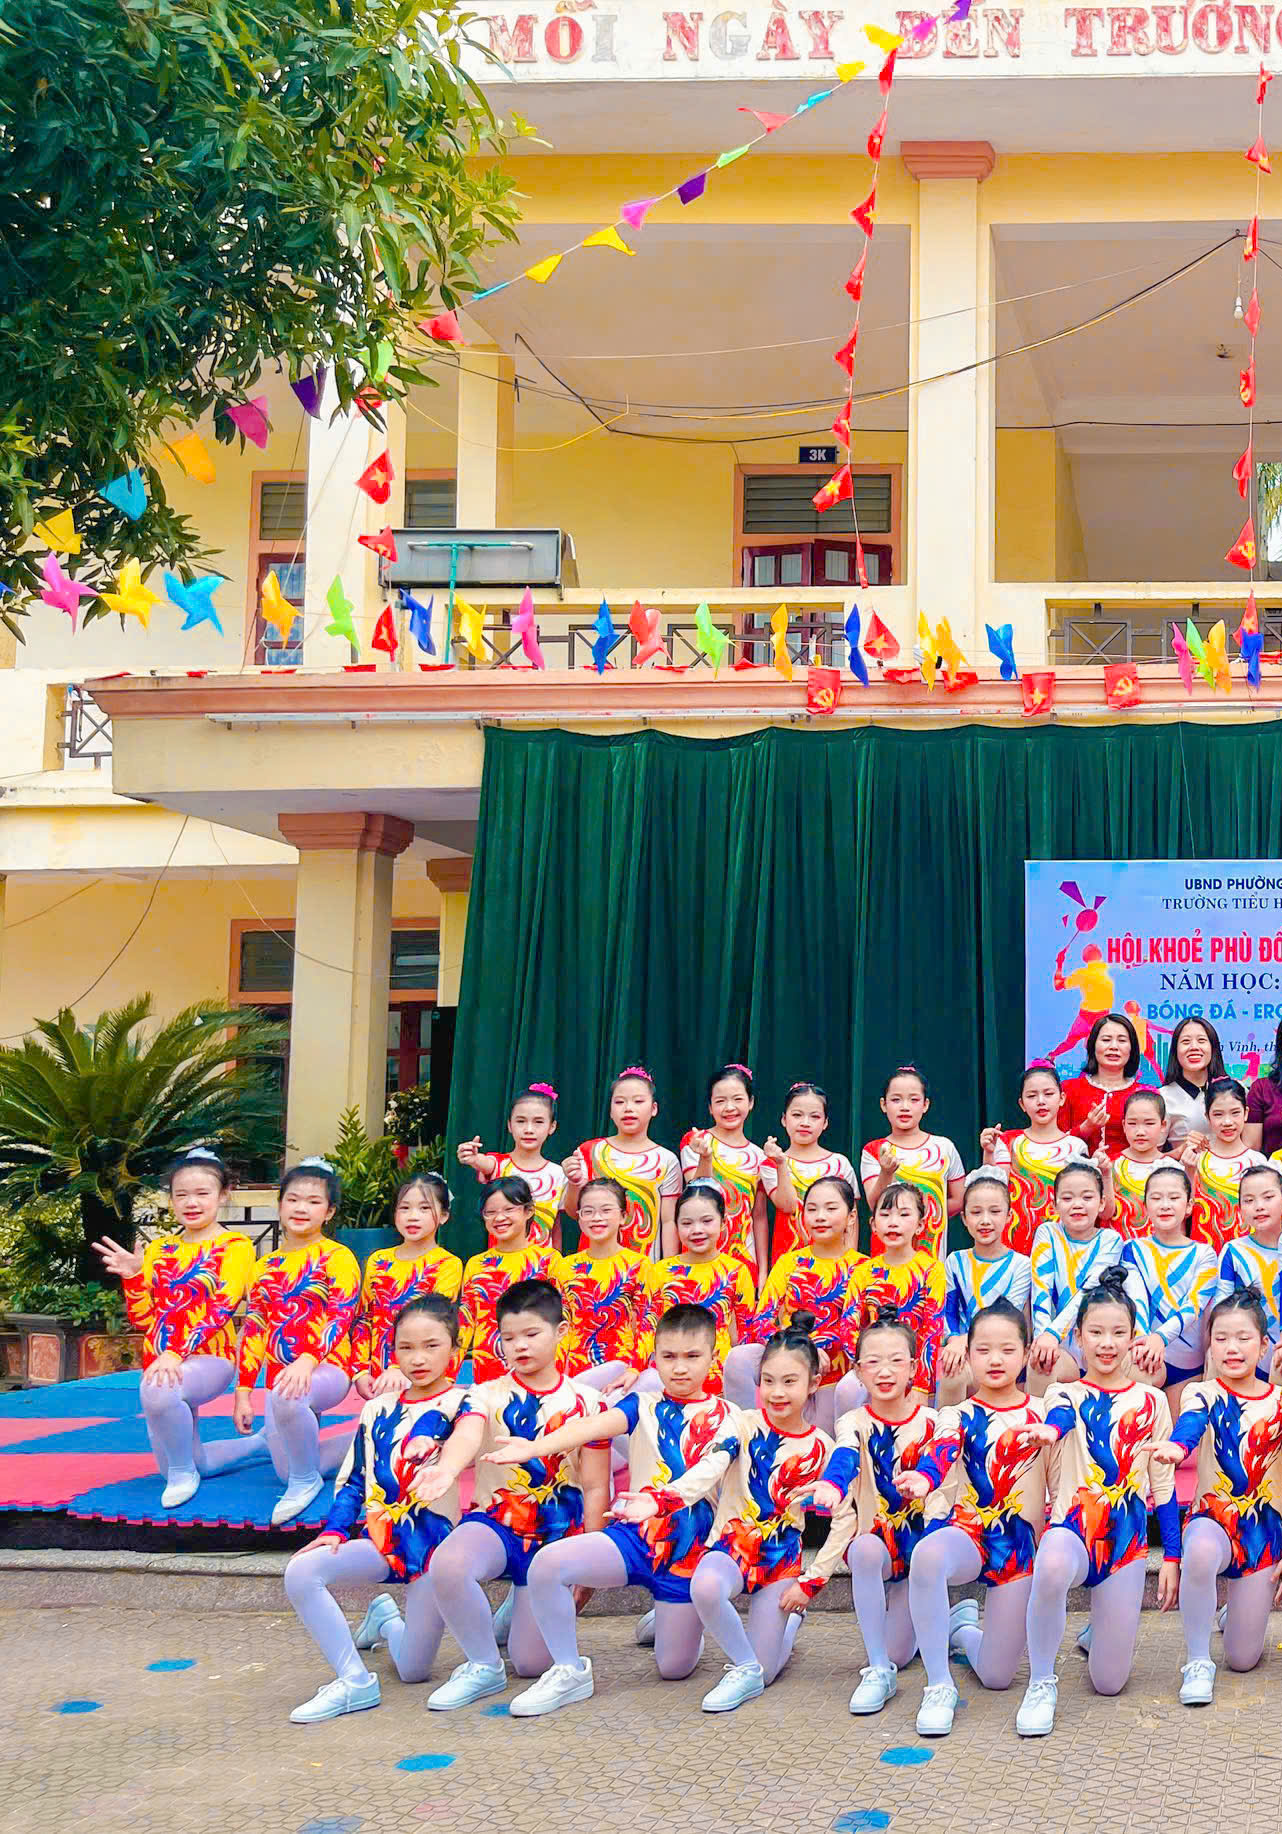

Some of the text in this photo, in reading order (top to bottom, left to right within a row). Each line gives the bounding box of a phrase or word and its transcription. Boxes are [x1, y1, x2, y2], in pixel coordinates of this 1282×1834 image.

[662, 0, 844, 61] NGÀY
[809, 449, 827, 461] 3K
[1185, 878, 1222, 890] UBND
[1162, 894, 1228, 910] TRƯỜNG
[1232, 892, 1269, 910] TIỂU
[1107, 932, 1142, 969] HỘI
[1150, 928, 1203, 963] KHOẺ
[1210, 931, 1252, 963] PHÙ
[1160, 969, 1214, 990] NĂM
[1222, 973, 1280, 994] HỌC:
[1147, 1000, 1203, 1019] BÓNG
[1210, 999, 1237, 1019] ĐÁ
[1225, 1041, 1260, 1053] Vinh,
